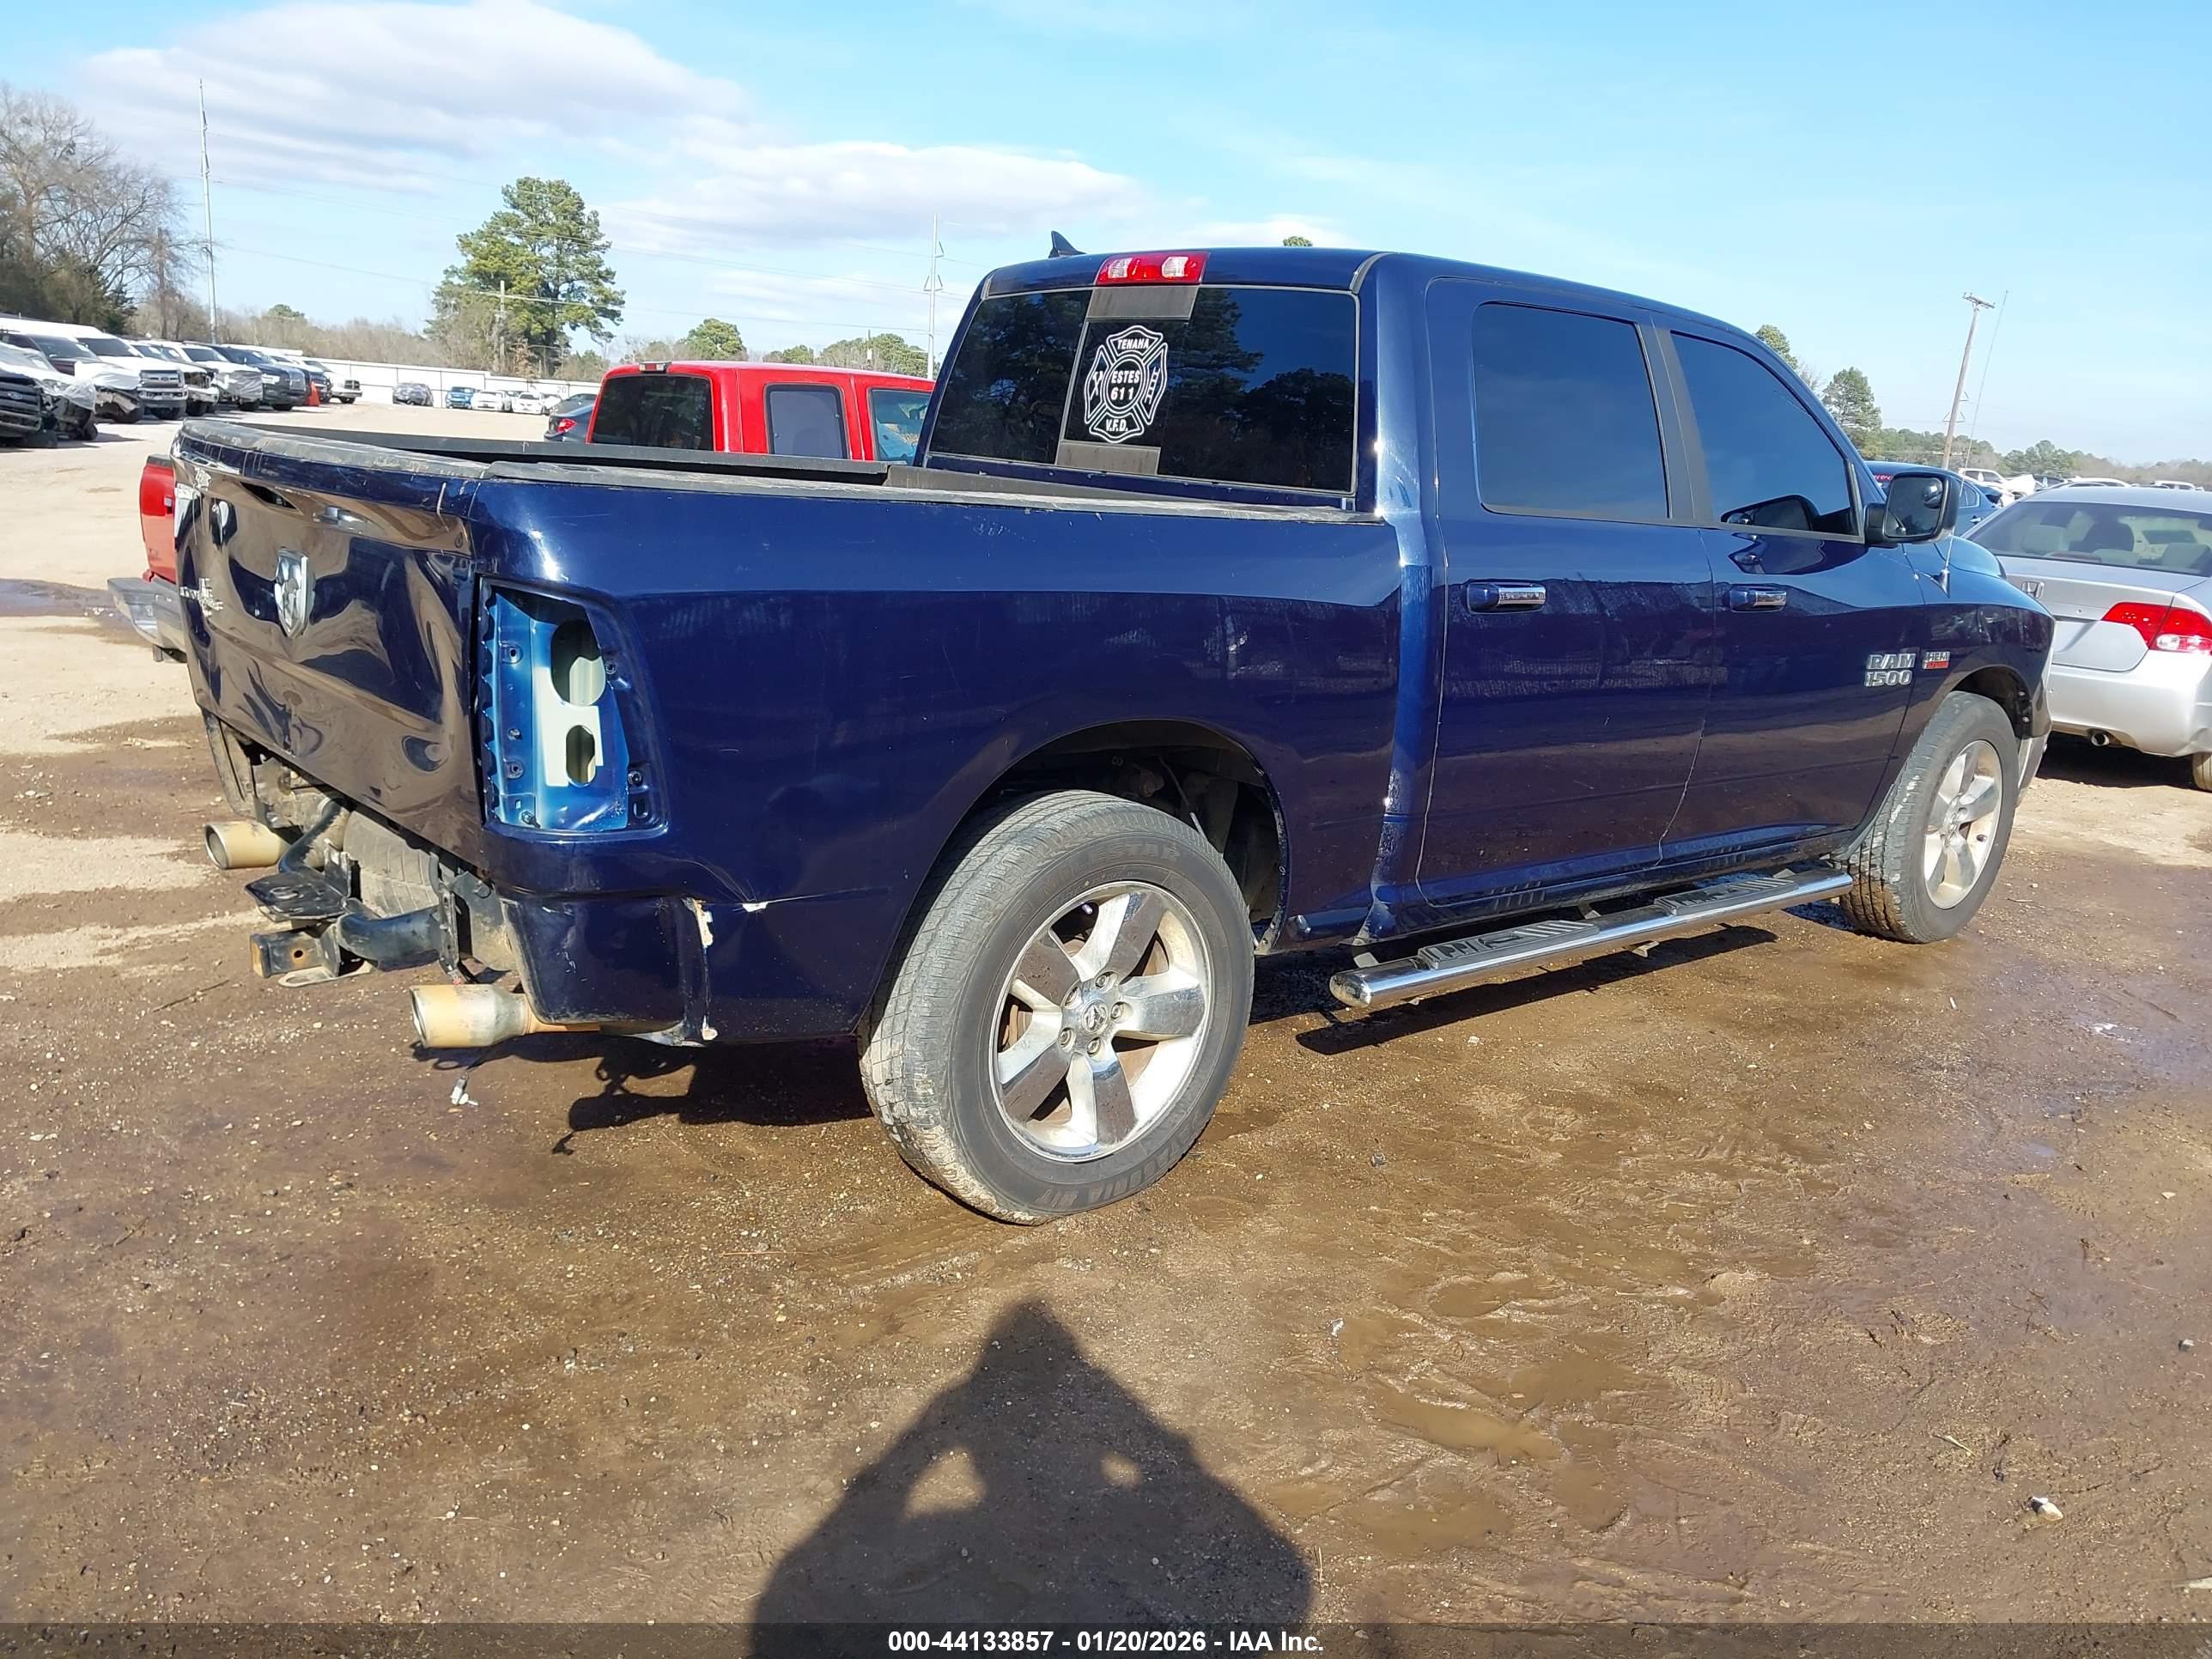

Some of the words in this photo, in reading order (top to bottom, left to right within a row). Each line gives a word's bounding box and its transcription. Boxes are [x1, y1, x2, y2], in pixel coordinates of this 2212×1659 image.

[1116, 337, 1150, 350] TENAHA
[1111, 370, 1140, 384] ESTES
[1110, 387, 1134, 400] 611
[1105, 418, 1129, 432] V.F.D.
[1867, 653, 1916, 669] RAM
[1864, 670, 1913, 687] 1500
